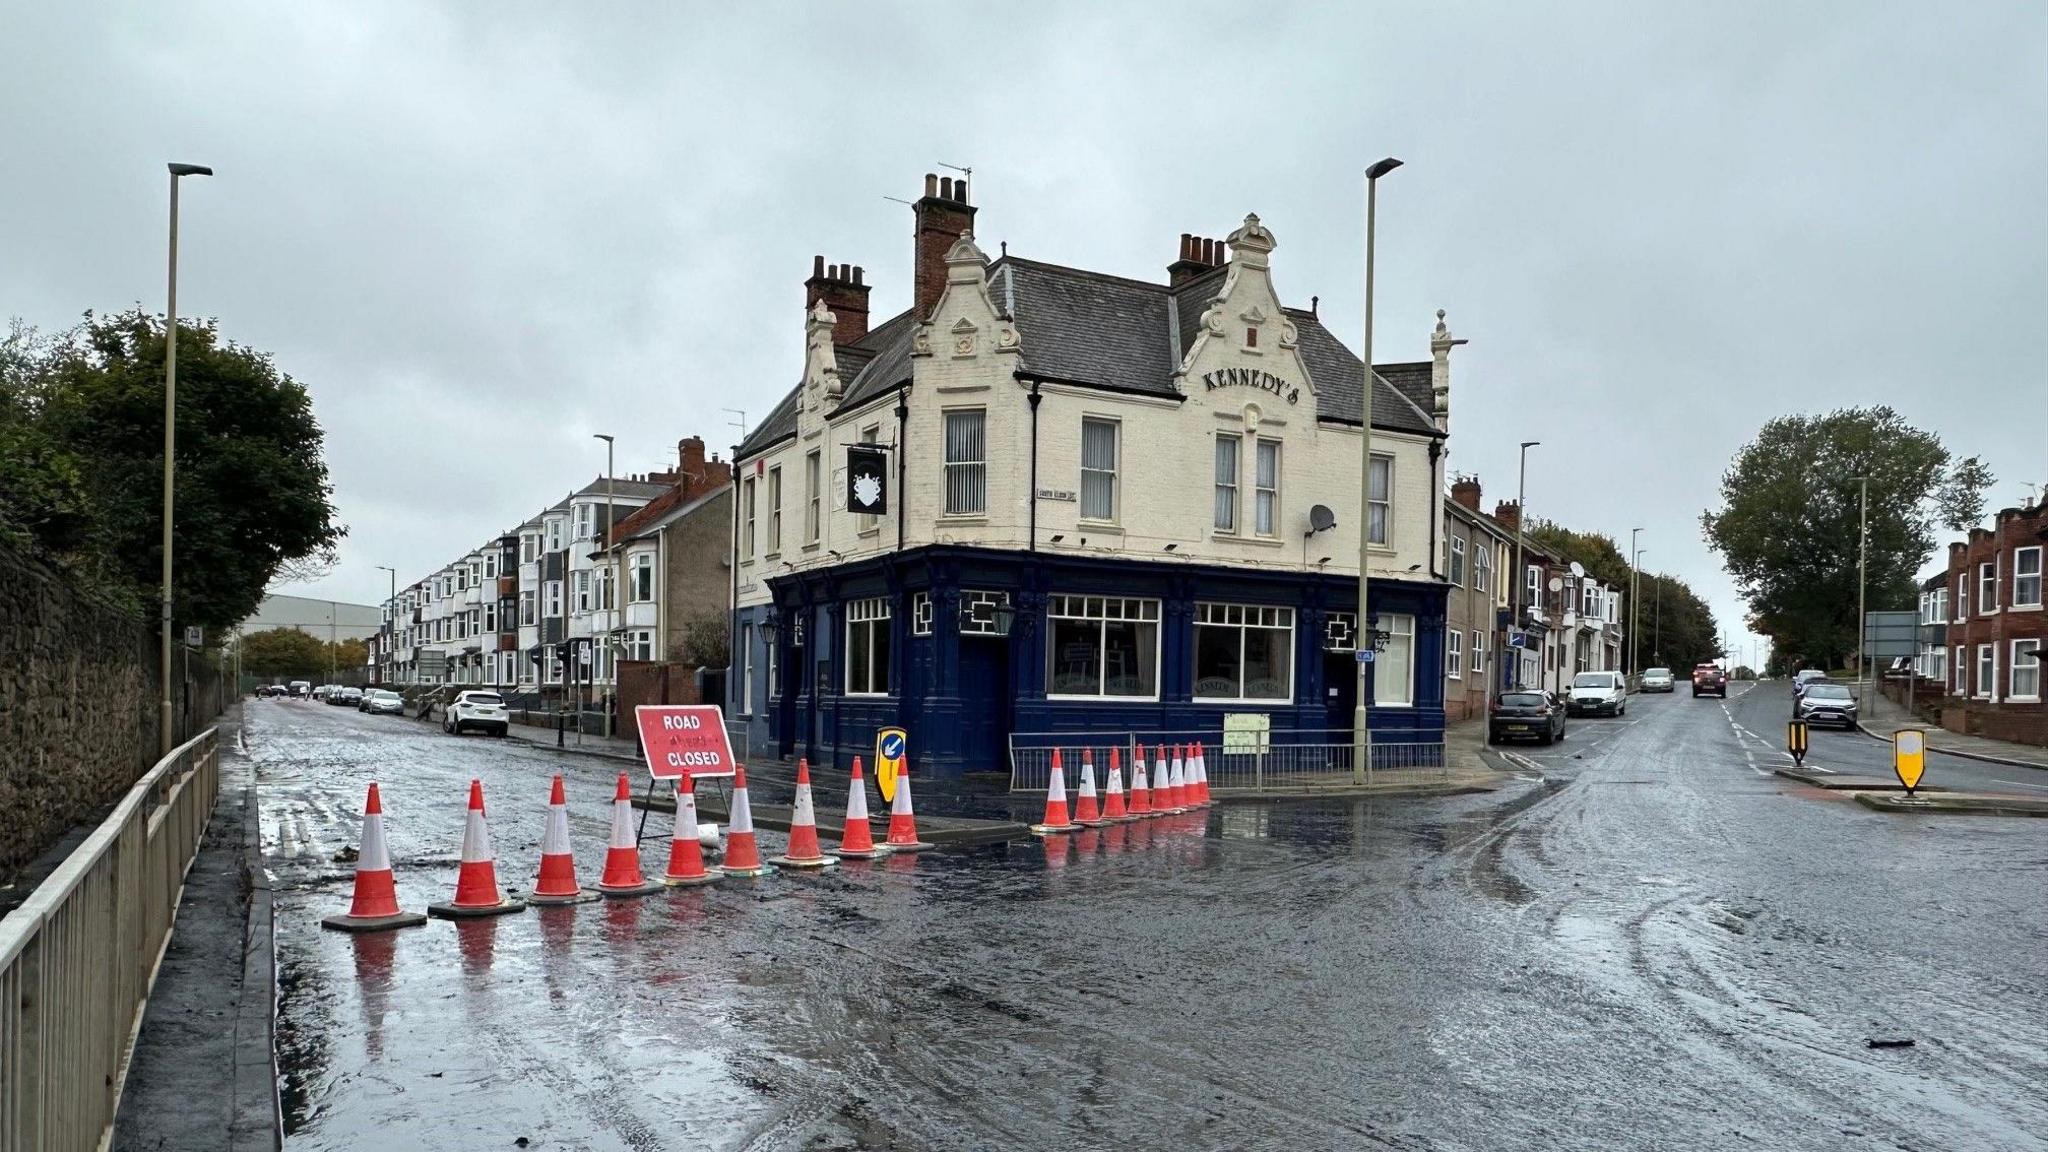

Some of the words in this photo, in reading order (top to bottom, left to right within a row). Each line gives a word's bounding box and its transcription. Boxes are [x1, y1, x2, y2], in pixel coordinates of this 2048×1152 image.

[1202, 367, 1299, 406] KENNEDY'S
[663, 715, 701, 730] ROAD
[667, 751, 720, 766] CLOSED
